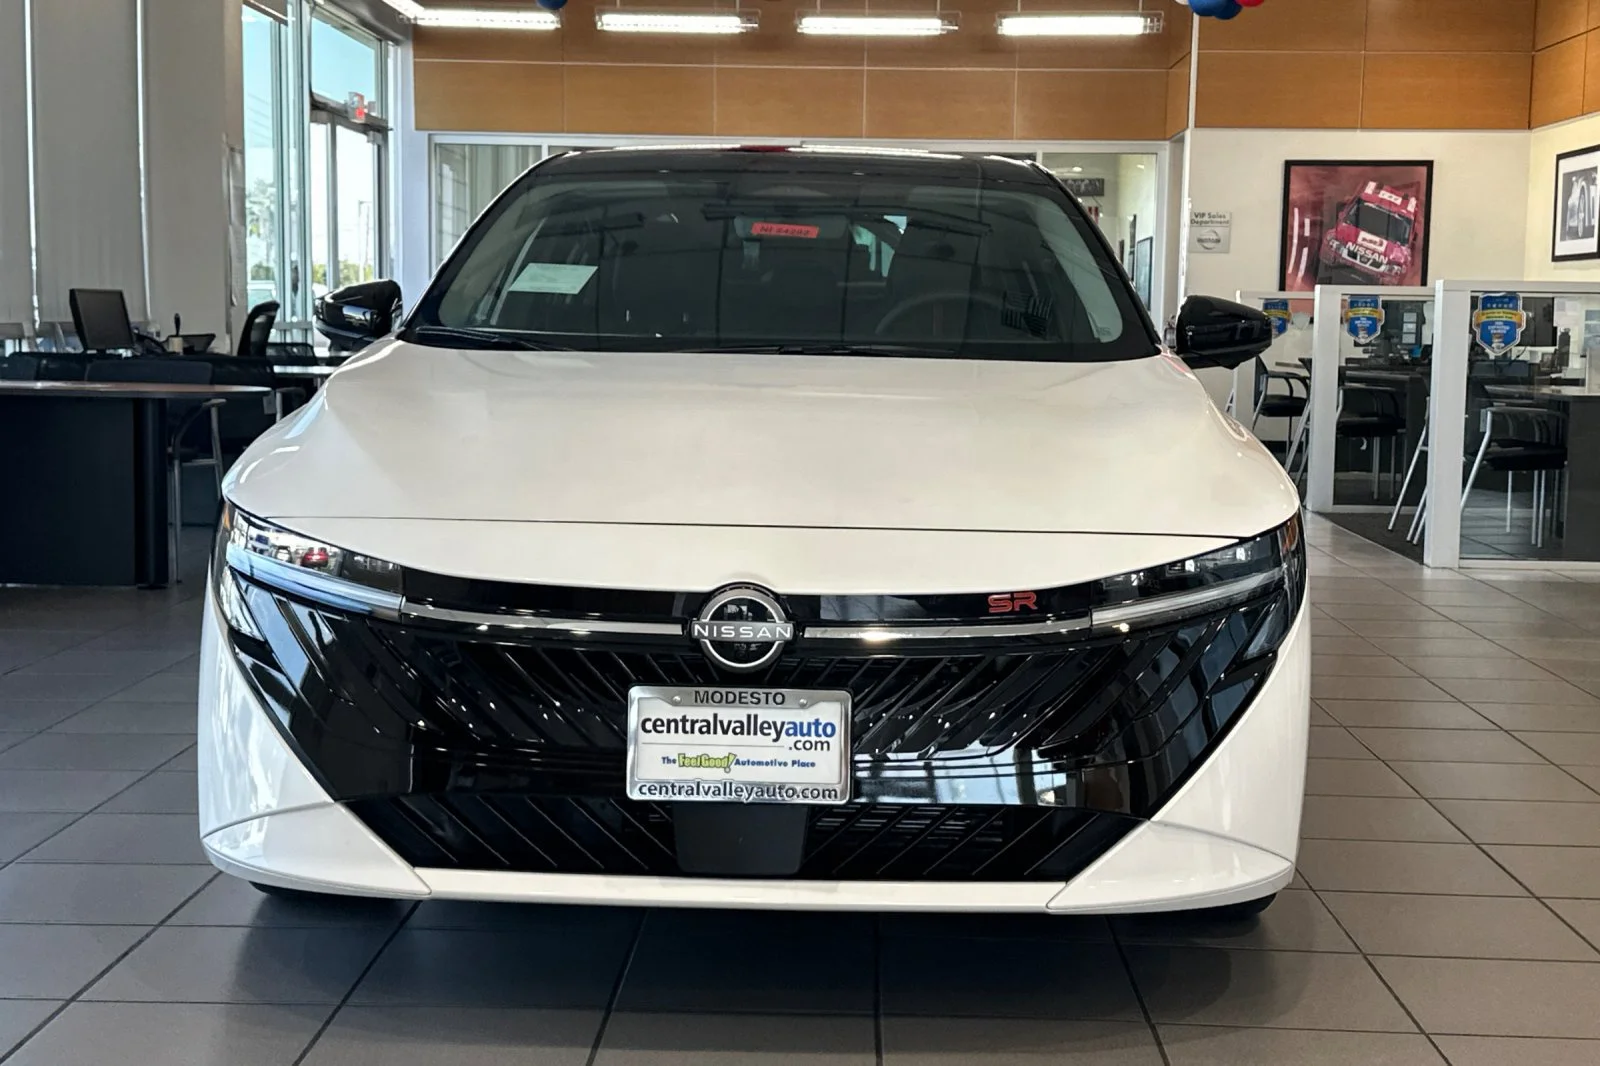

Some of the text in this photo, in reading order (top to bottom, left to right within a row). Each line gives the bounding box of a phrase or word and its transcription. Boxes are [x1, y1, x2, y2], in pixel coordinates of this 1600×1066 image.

[1208, 211, 1226, 219] Sales
[1346, 242, 1388, 263] NISSAN
[987, 592, 1038, 613] SR
[693, 624, 792, 639] NISSAN
[694, 690, 786, 705] MODESTO
[640, 713, 836, 742] centralvalleyauto
[788, 739, 831, 752] .com
[661, 756, 677, 764] The
[734, 757, 788, 767] Automotive
[638, 782, 838, 800] centralvalleyauto.com
